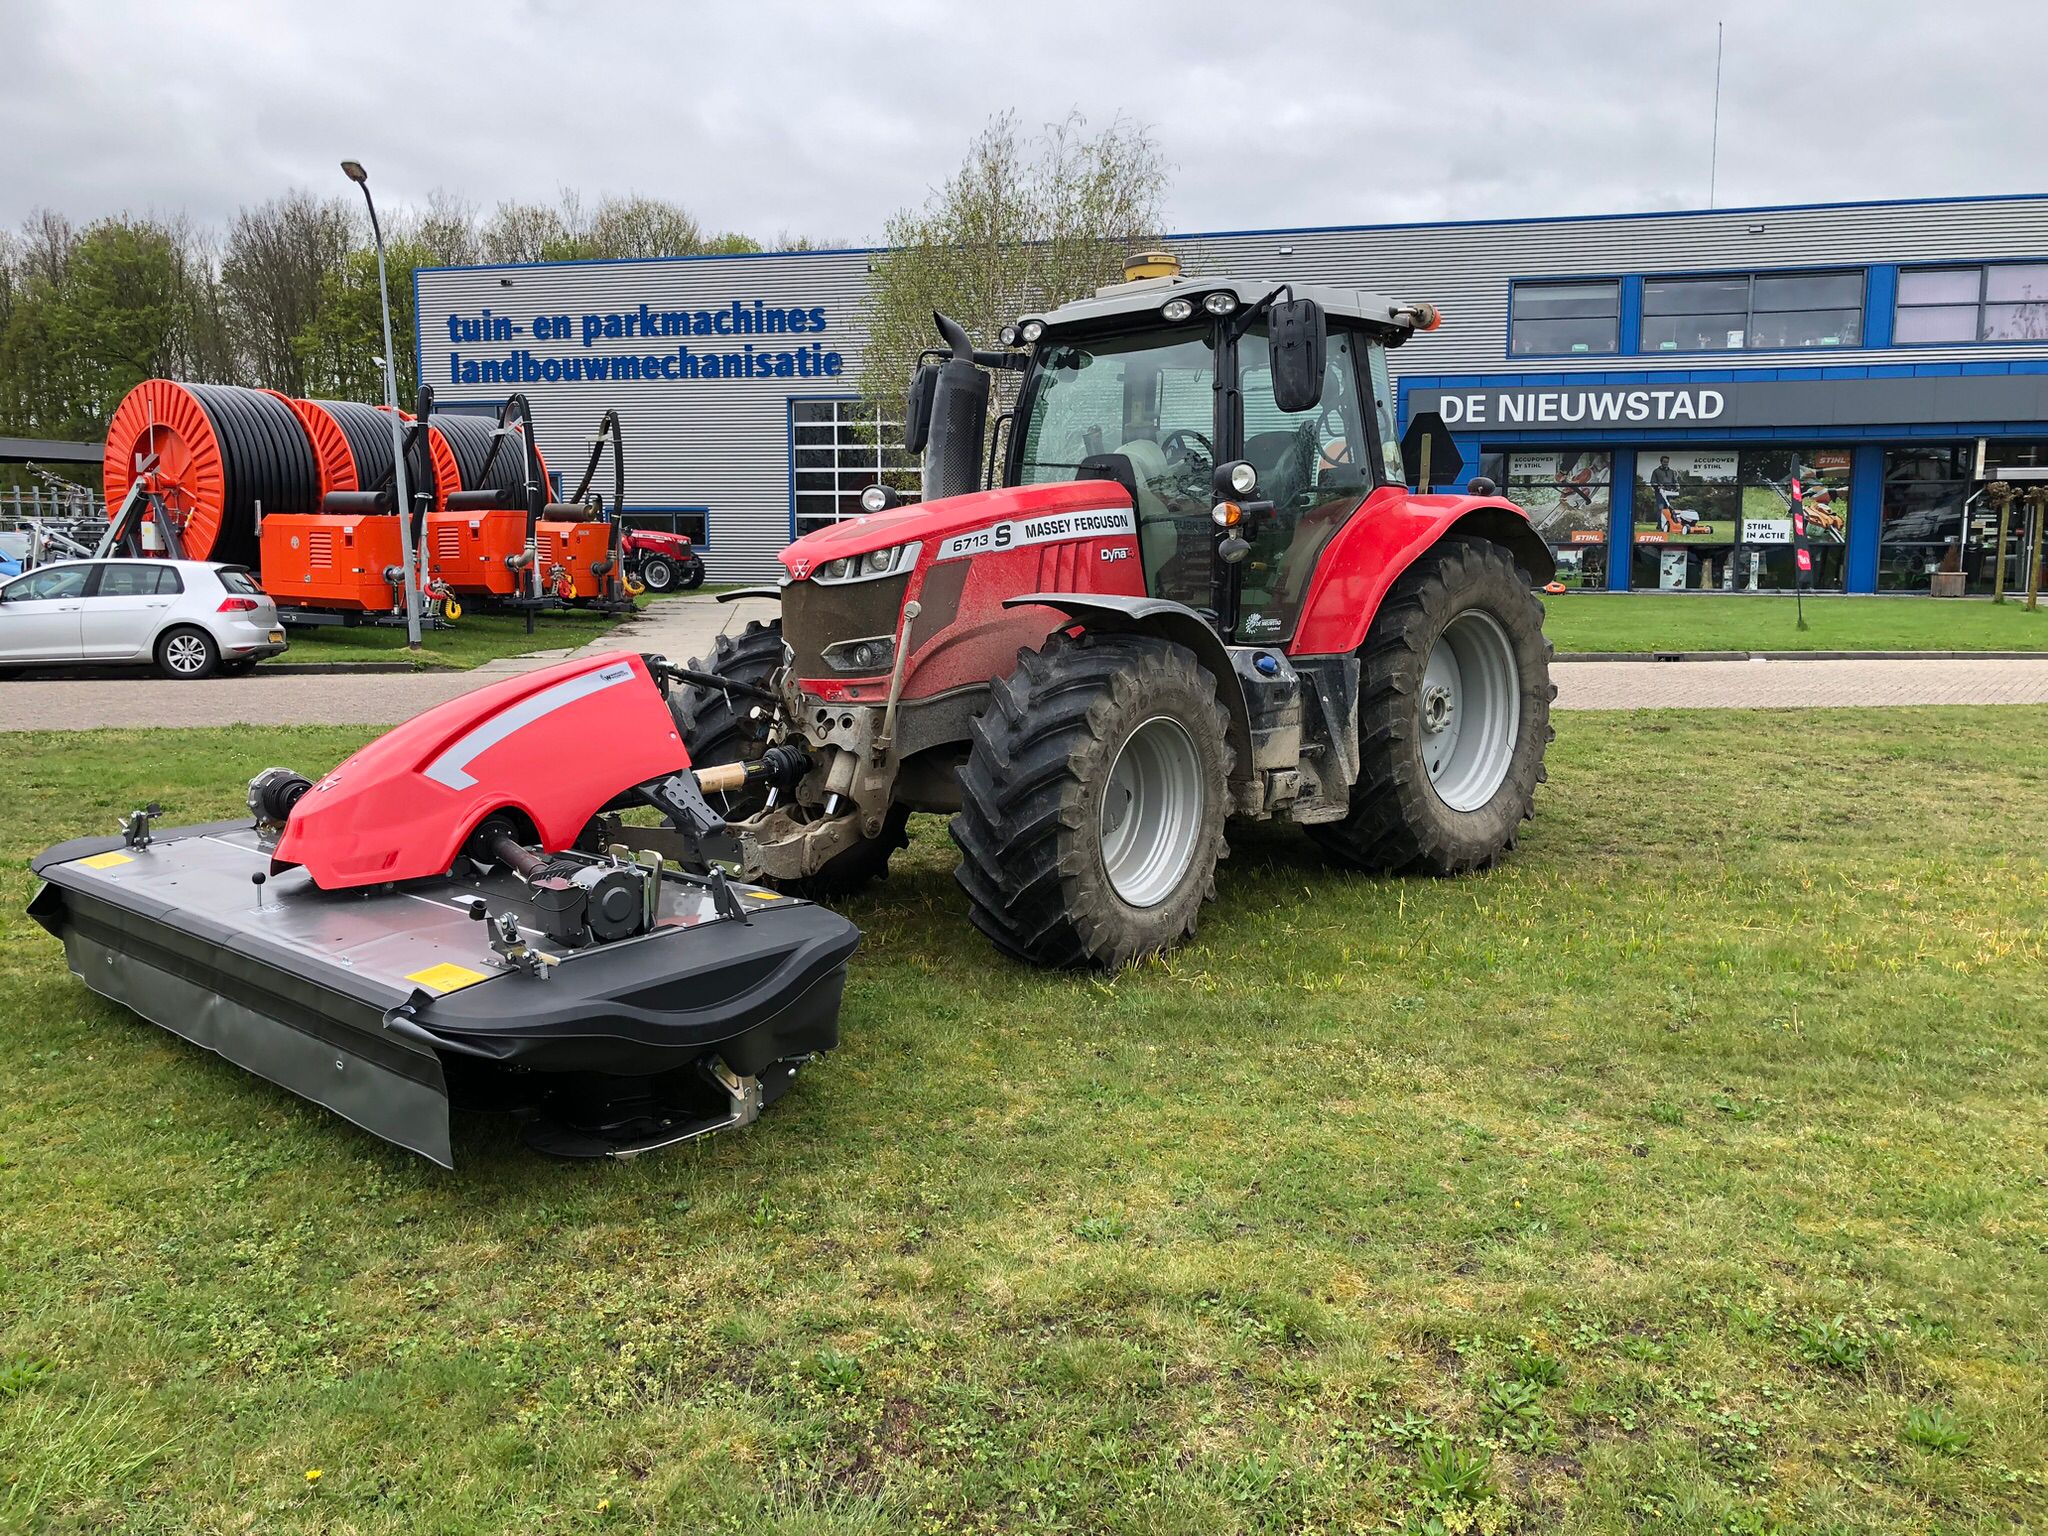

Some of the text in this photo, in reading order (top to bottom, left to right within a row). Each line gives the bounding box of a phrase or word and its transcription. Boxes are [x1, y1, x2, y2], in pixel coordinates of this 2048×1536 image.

[447, 300, 827, 347] tuin- en parkmachines
[450, 342, 844, 385] landbouwmechanisatie
[1439, 390, 1724, 424] DE NIEUWSTAD
[953, 515, 1129, 552] 6713 S MASSEY FERGUSON
